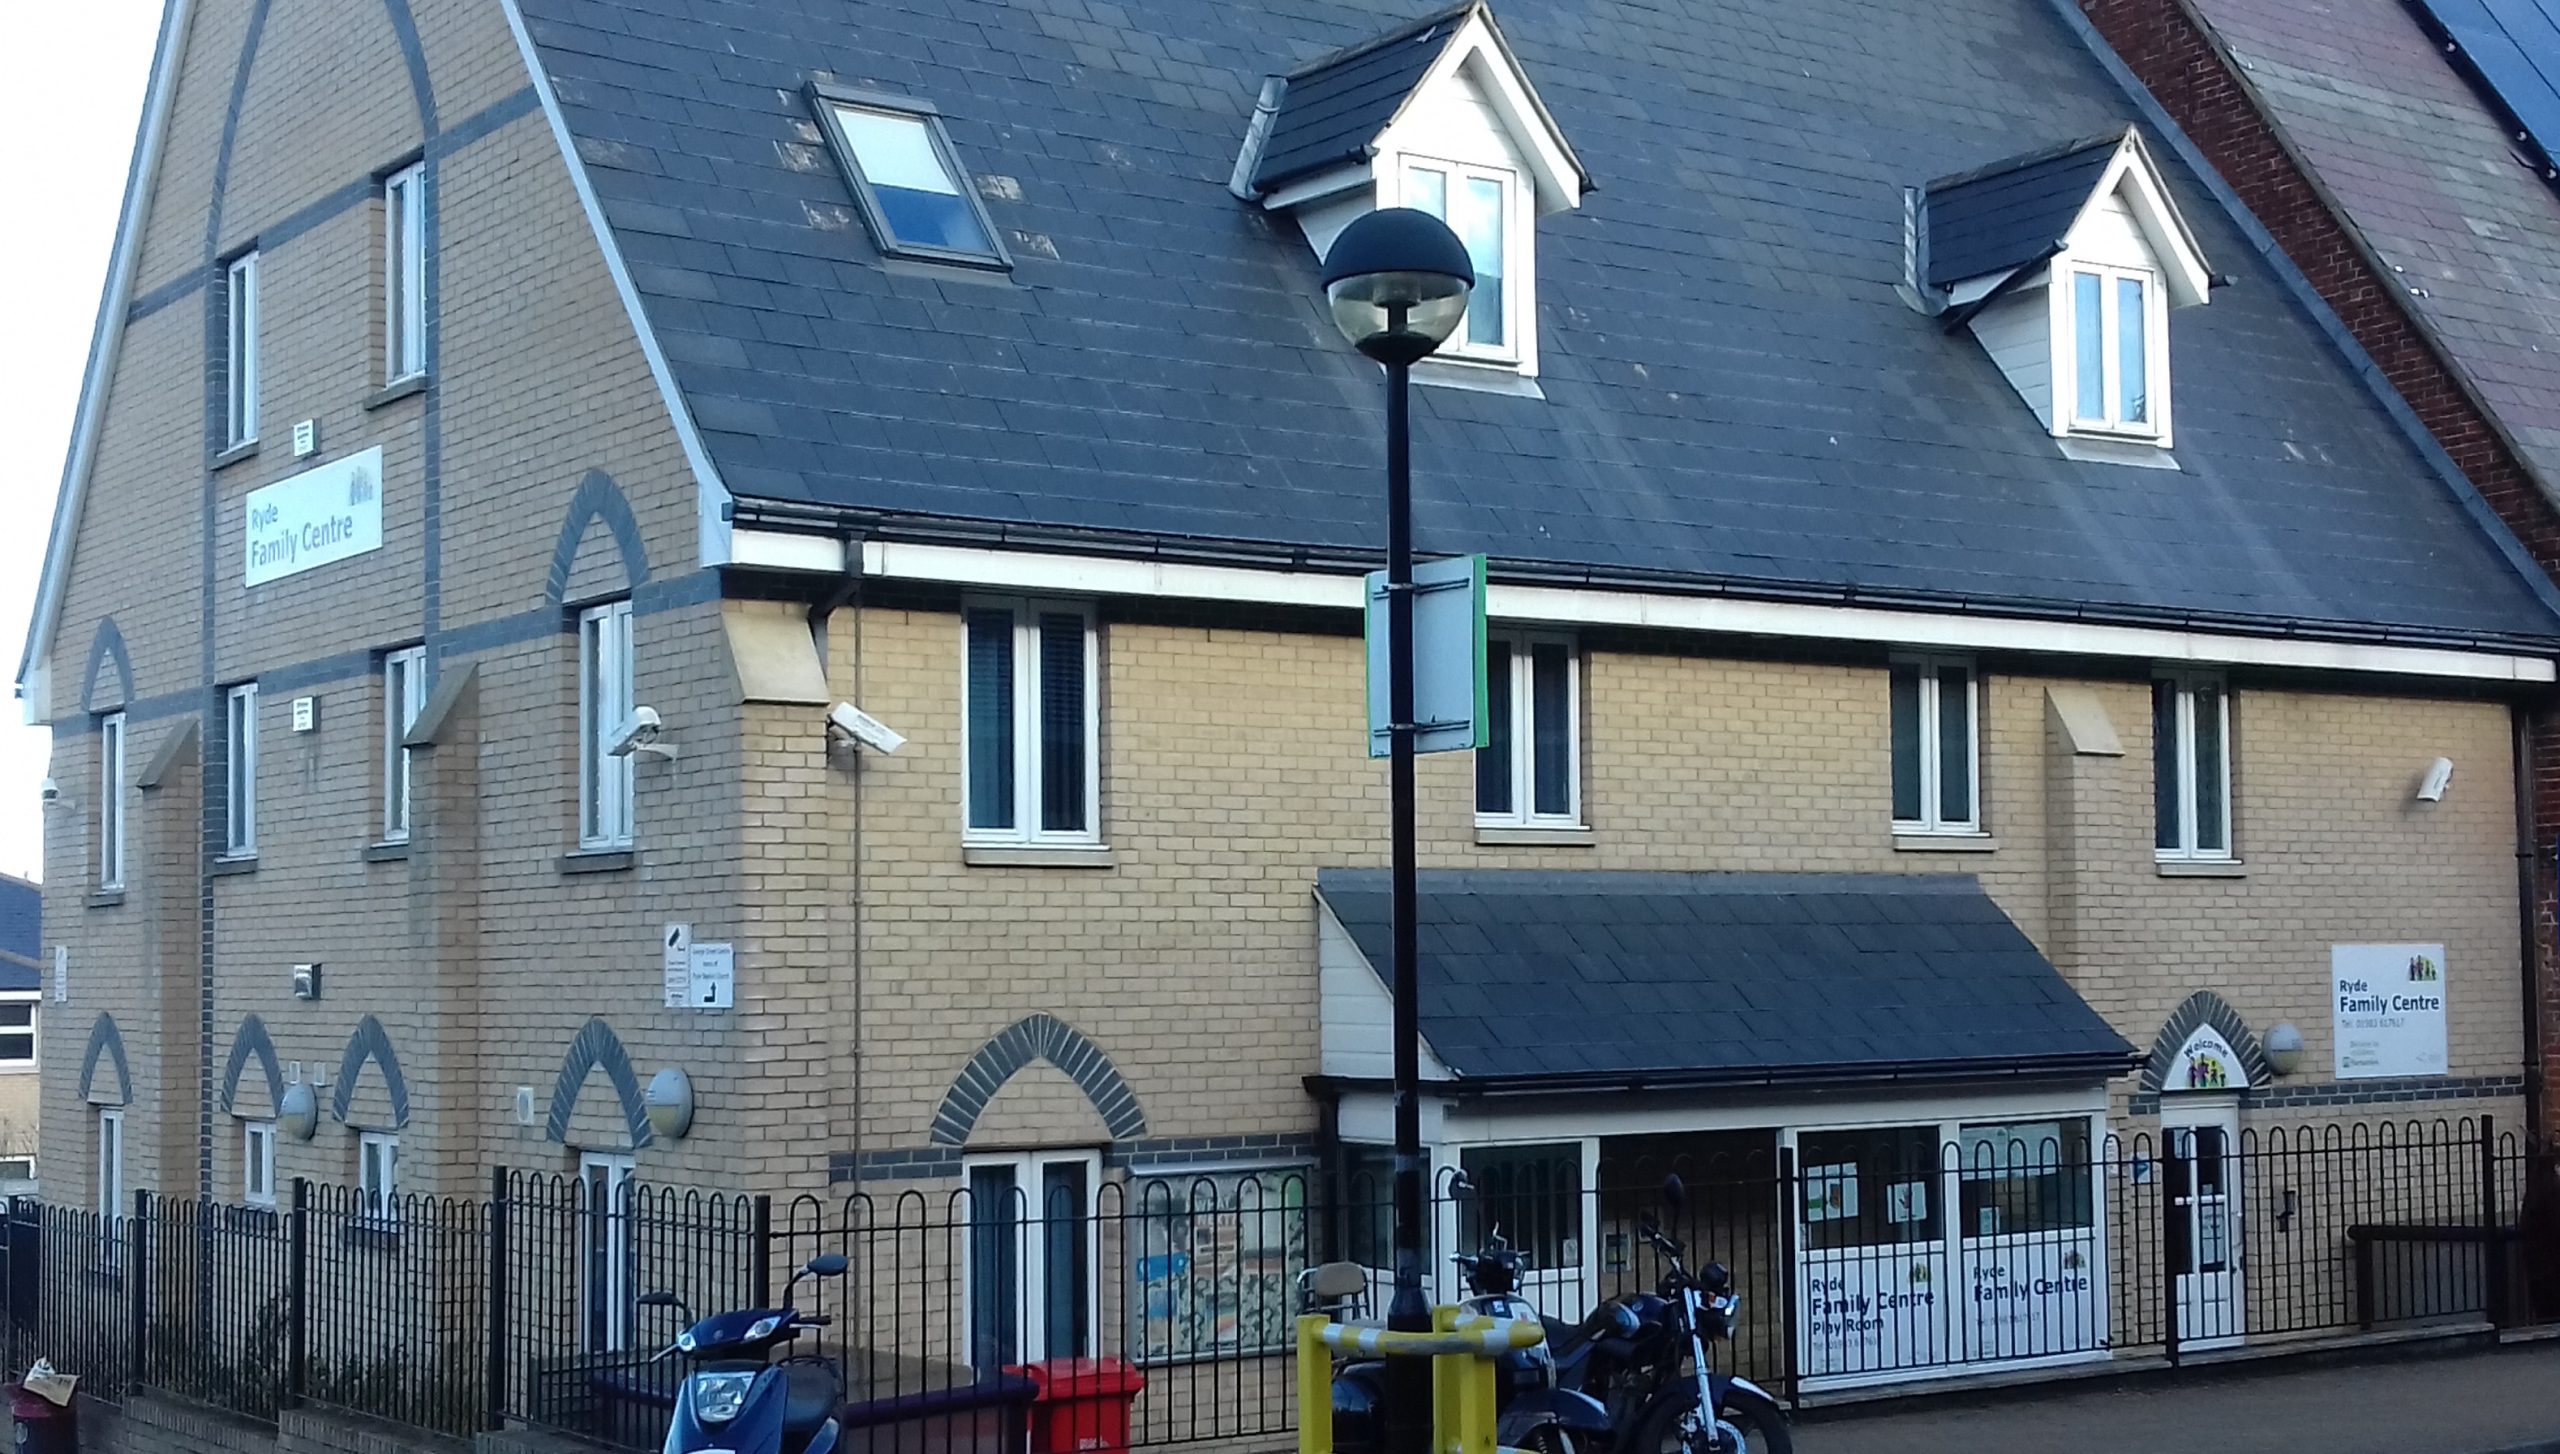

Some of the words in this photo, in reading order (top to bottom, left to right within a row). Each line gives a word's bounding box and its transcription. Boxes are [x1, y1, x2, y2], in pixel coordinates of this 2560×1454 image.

[251, 503, 279, 532] Ryde
[251, 529, 298, 568] Family
[302, 515, 354, 552] Centre
[2339, 979, 2368, 994] Ryde
[2340, 995, 2388, 1015] Family
[2392, 994, 2440, 1012] Centre
[2183, 1038, 2229, 1059] Welcome
